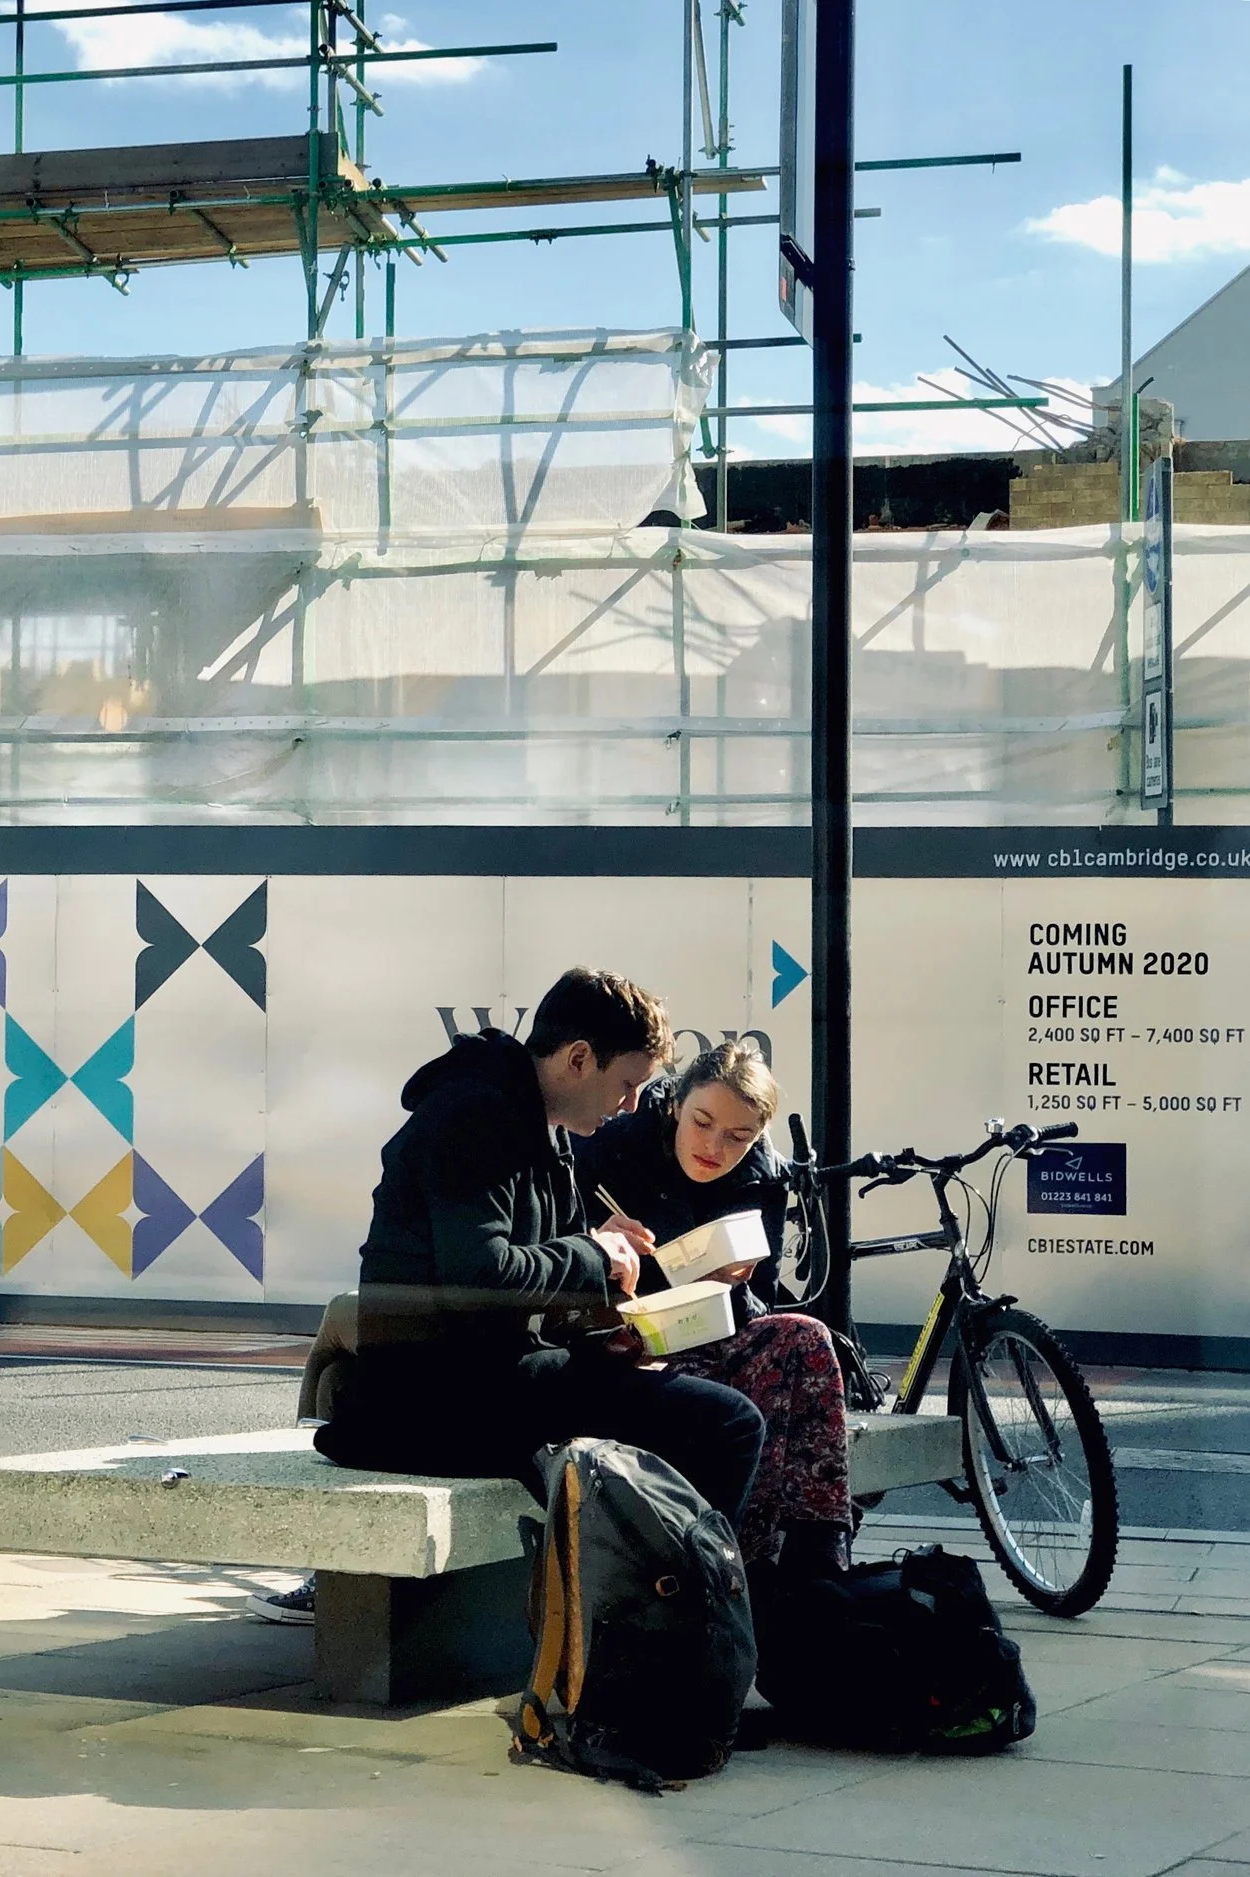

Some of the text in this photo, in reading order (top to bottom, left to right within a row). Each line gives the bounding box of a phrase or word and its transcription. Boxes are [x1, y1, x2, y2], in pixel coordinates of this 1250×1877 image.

[1048, 849, 1250, 870] cb1cambridge.co.uk
[1030, 923, 1127, 946] COMING
[1028, 951, 1209, 975] AUTUMN 2020
[1029, 995, 1118, 1018] OFFICE
[1028, 1027, 1075, 1043] 2,400
[1080, 1027, 1100, 1043] SQ
[1106, 1028, 1125, 1042] FT
[1146, 1028, 1193, 1045] 7,400
[1199, 1028, 1219, 1045] SQ
[1226, 1028, 1245, 1043] FT
[1028, 1062, 1117, 1086] RETAIL
[1027, 1095, 1071, 1111] 1,250
[1076, 1095, 1097, 1111] SQ
[1102, 1096, 1121, 1110] FT
[1142, 1096, 1191, 1112] 5,000
[1196, 1097, 1216, 1113] SQ
[1223, 1097, 1242, 1112] FT
[1041, 1171, 1113, 1182] BIDWELLS
[1041, 1191, 1112, 1202] 01223 841 841
[1028, 1238, 1154, 1255] CB1ESTATE.COM
